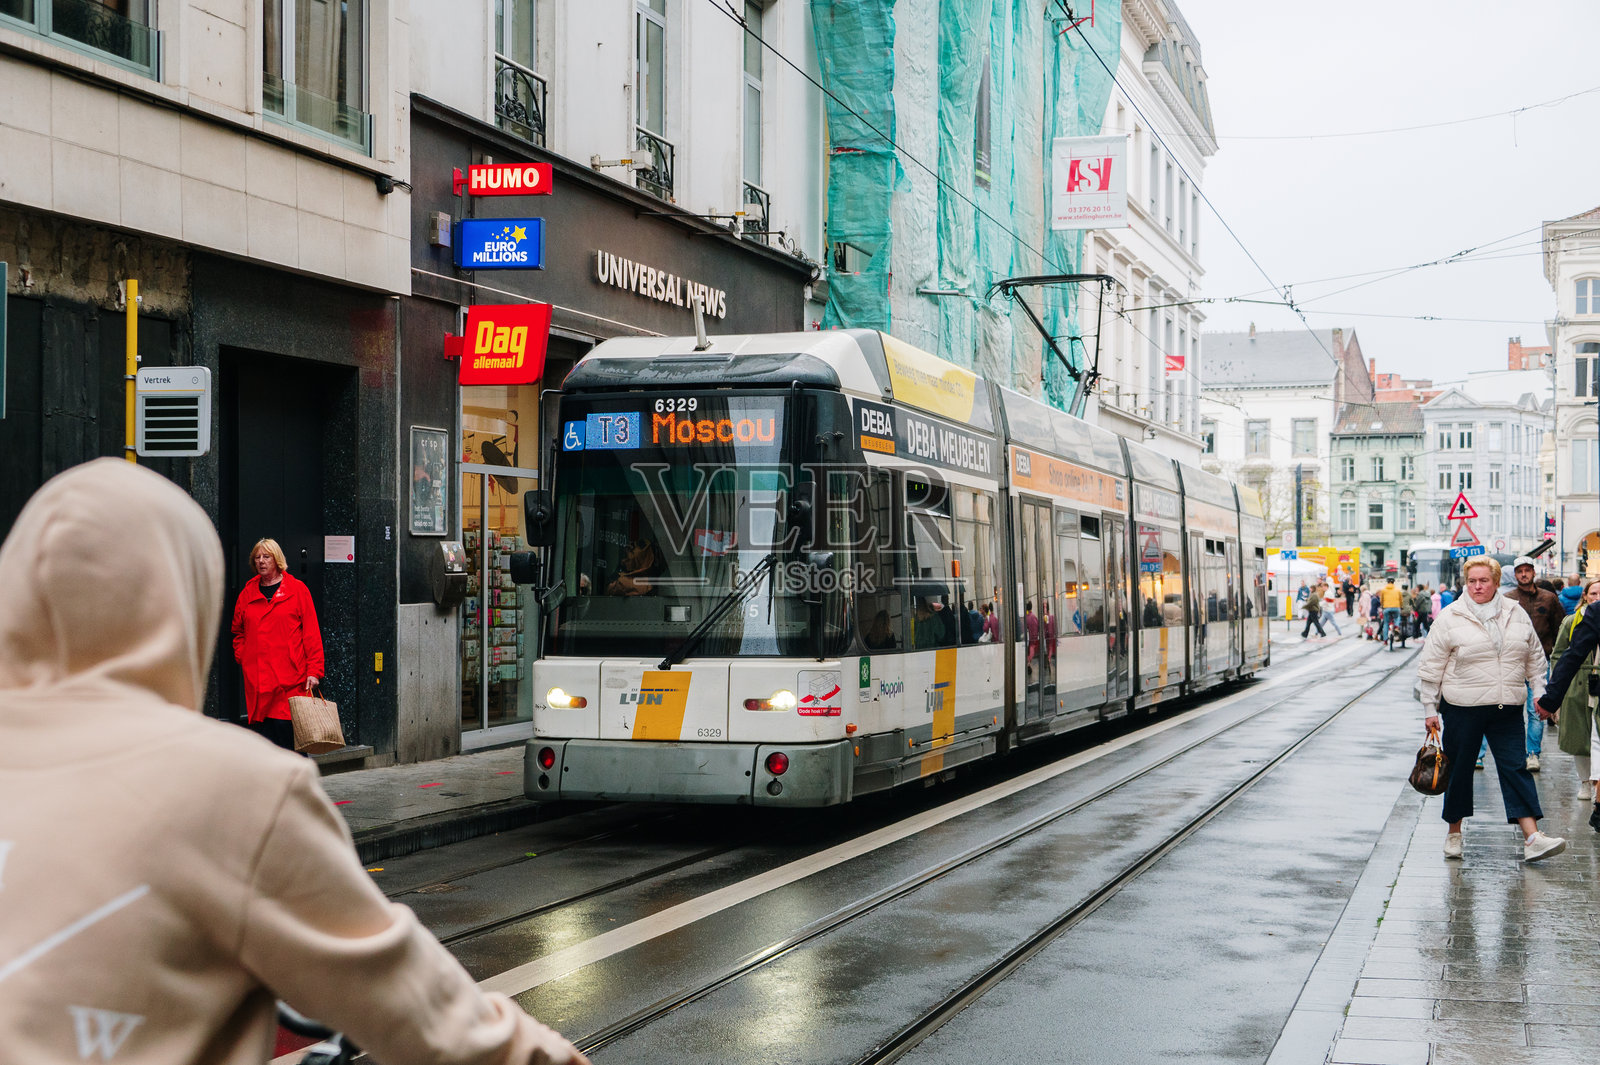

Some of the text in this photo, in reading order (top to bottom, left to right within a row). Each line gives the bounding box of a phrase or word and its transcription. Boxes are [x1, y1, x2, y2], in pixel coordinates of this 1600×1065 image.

[471, 168, 540, 189] HUMO
[484, 241, 517, 252] EURO
[472, 252, 528, 262] MILLIONS
[597, 250, 727, 319] UNIVERSAL NEWS
[474, 320, 528, 368] Dag
[473, 355, 516, 369] allemaal
[144, 376, 171, 384] Vertrek
[654, 397, 698, 413] 6329
[599, 415, 630, 444] T3
[652, 412, 775, 444] Moscou
[861, 407, 893, 437] DEBA
[907, 418, 991, 474] DEBA MEUBELEN
[1015, 452, 1031, 476] DEBA
[1454, 548, 1468, 557] 20
[748, 604, 759, 618] 5
[697, 728, 722, 738] 6329
